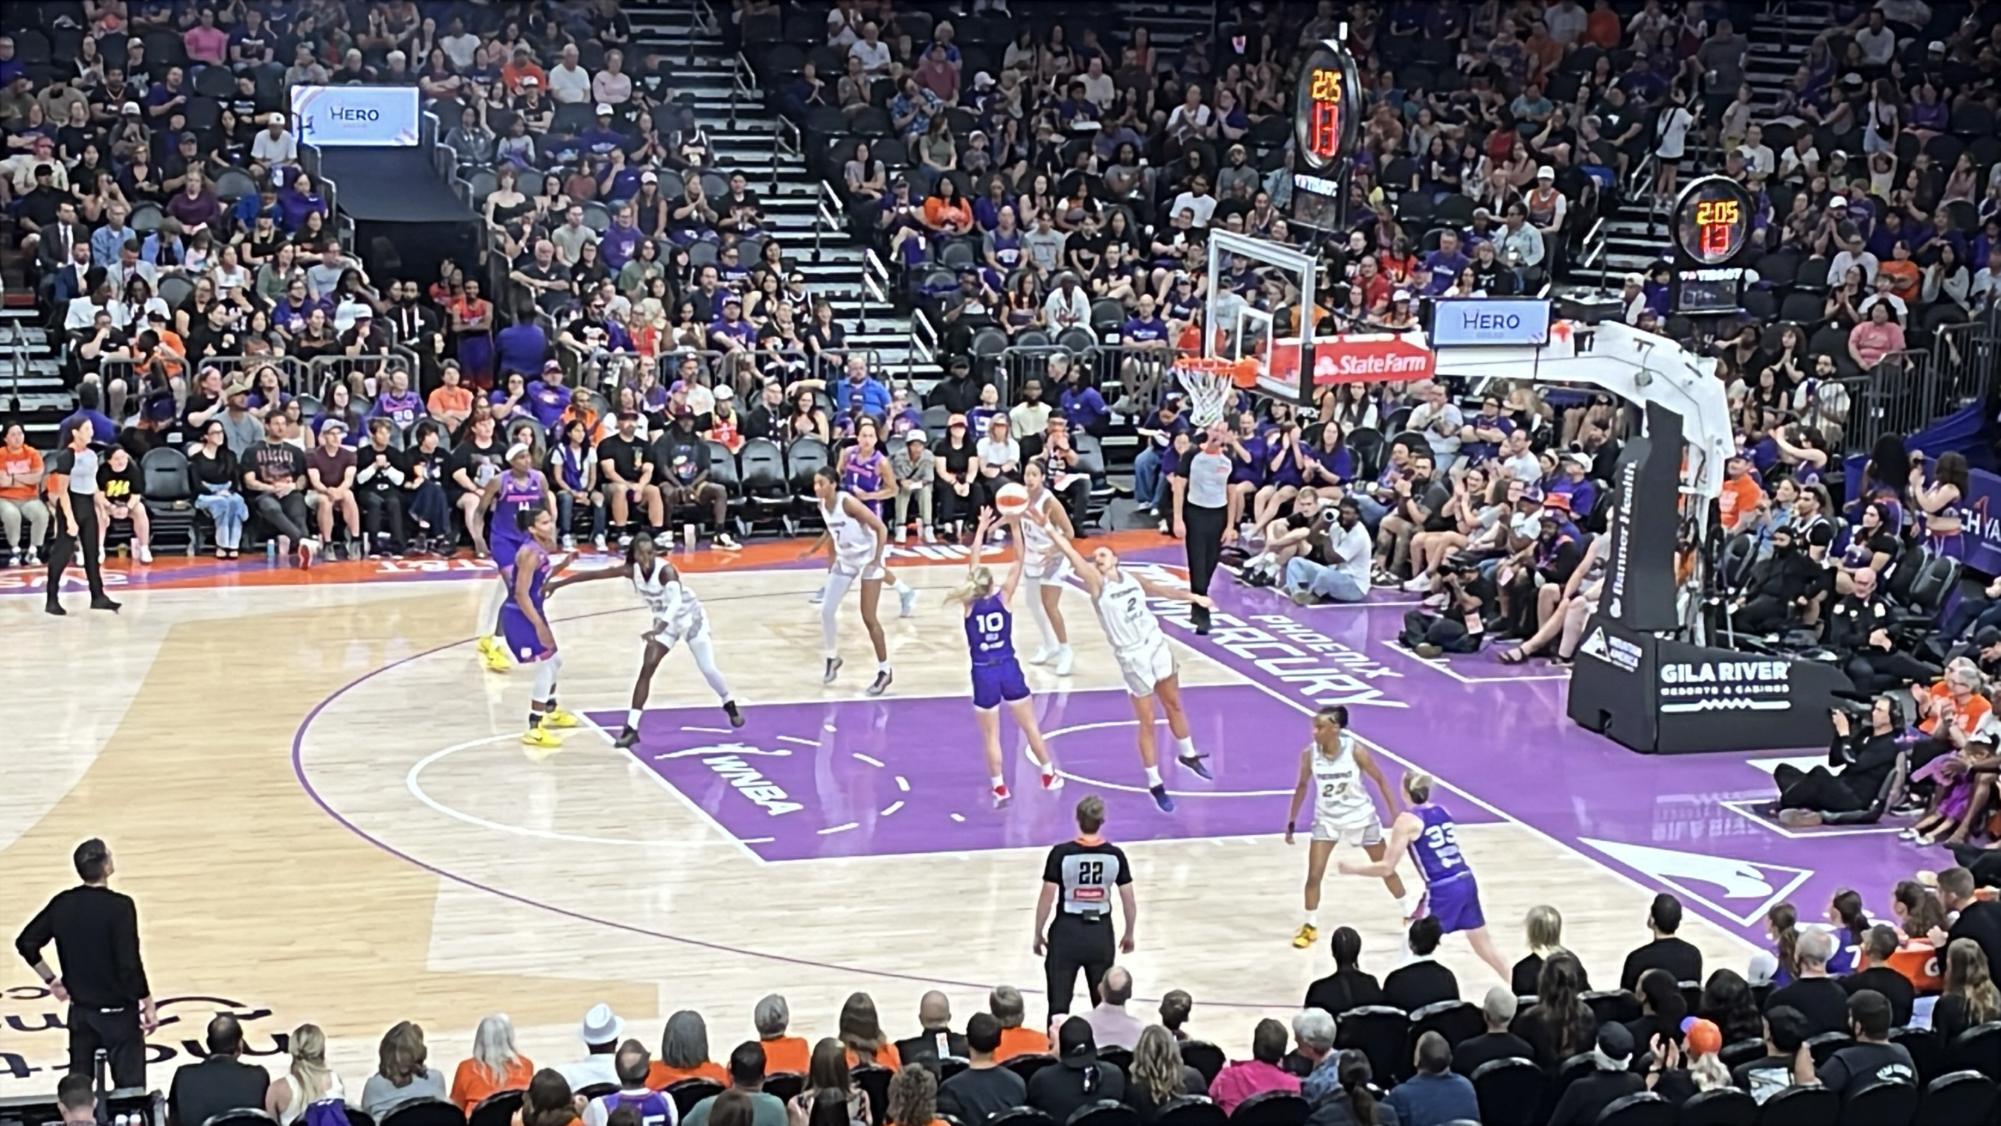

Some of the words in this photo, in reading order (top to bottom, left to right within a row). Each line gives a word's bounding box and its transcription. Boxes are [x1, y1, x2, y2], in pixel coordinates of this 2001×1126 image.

[330, 106, 380, 121] HERO
[1697, 201, 1739, 225] 2:05
[1463, 309, 1521, 330] HERO
[975, 612, 1004, 634] 10
[1249, 614, 1404, 678] PHOENIX
[1661, 663, 1717, 683] GILA
[1718, 661, 1788, 682] RIVER
[702, 755, 804, 816] WNBA
[1322, 782, 1348, 798] 23
[1425, 822, 1456, 848] 33
[1079, 861, 1104, 885] 22
[1844, 945, 1861, 969] 7
